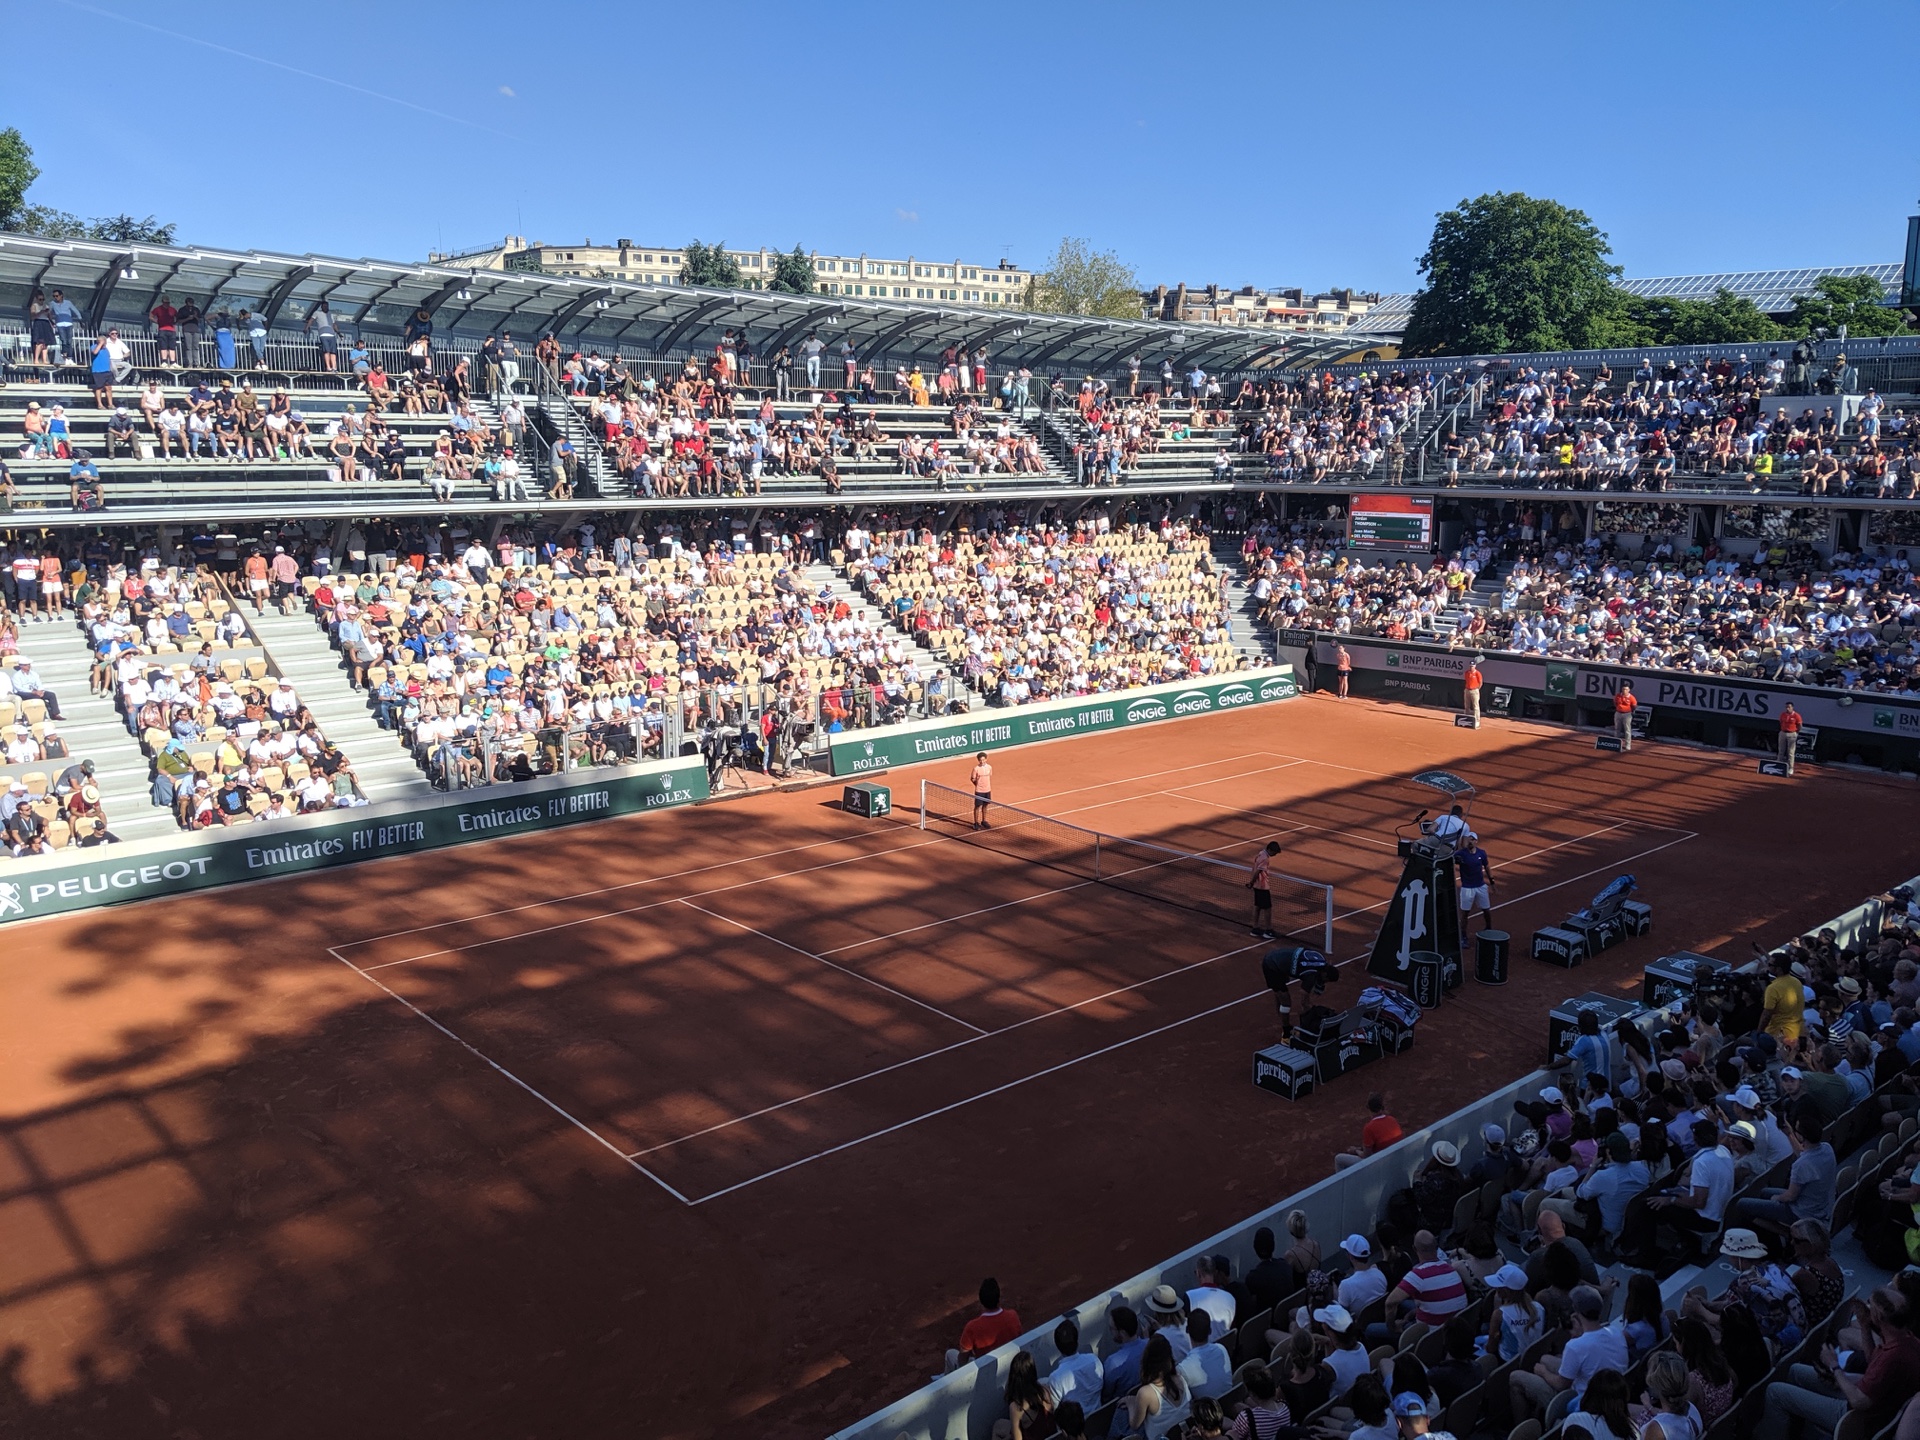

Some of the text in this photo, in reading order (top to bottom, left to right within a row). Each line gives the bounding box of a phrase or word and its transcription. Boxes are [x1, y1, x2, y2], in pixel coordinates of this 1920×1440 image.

[1403, 655, 1464, 670] BNP PARIBAS
[1384, 679, 1431, 691] BNP PARIBAS
[1658, 682, 1769, 715] PARIBAS
[1028, 708, 1114, 735] Emirates FLY BETTER
[915, 725, 1011, 754] Emirates FLY BETTER
[1597, 741, 1620, 749] LACOSTE
[852, 755, 891, 770] ROLEX
[458, 790, 610, 832] Emirates FLY BETTER
[646, 789, 693, 807] ROLEX
[245, 821, 425, 869] Emirates FLY BETTER
[30, 856, 213, 903] PEUGEOT
[1534, 938, 1569, 958] perrier
[1256, 1060, 1292, 1087] perrier
